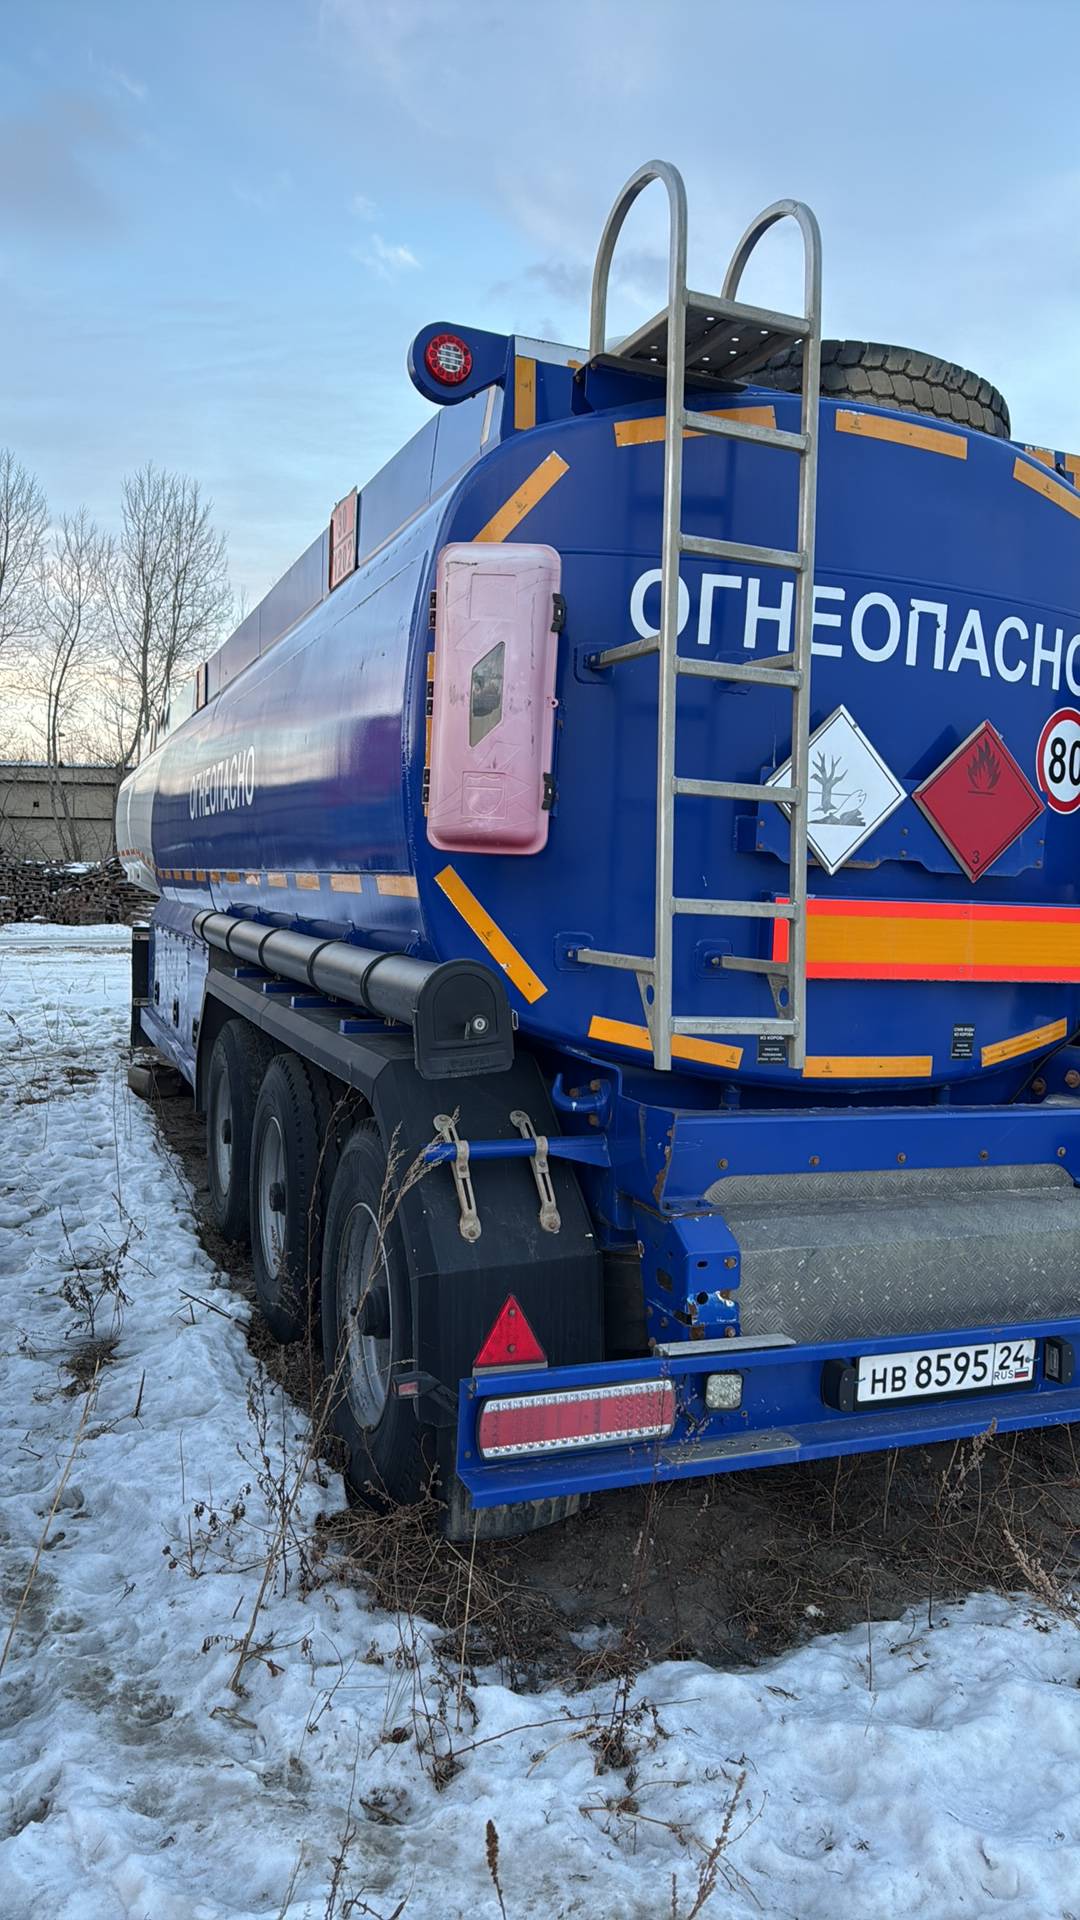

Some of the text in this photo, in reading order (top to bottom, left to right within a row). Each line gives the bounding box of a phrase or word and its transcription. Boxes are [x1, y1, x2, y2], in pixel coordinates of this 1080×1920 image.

[189, 745, 255, 820] ОГНЕОПАСНО
[1049, 737, 1080, 786] 80
[971, 850, 980, 865] 3
[915, 1349, 989, 1389] 8595
[998, 1344, 1025, 1371] 24
[994, 1369, 1014, 1381] RUS
